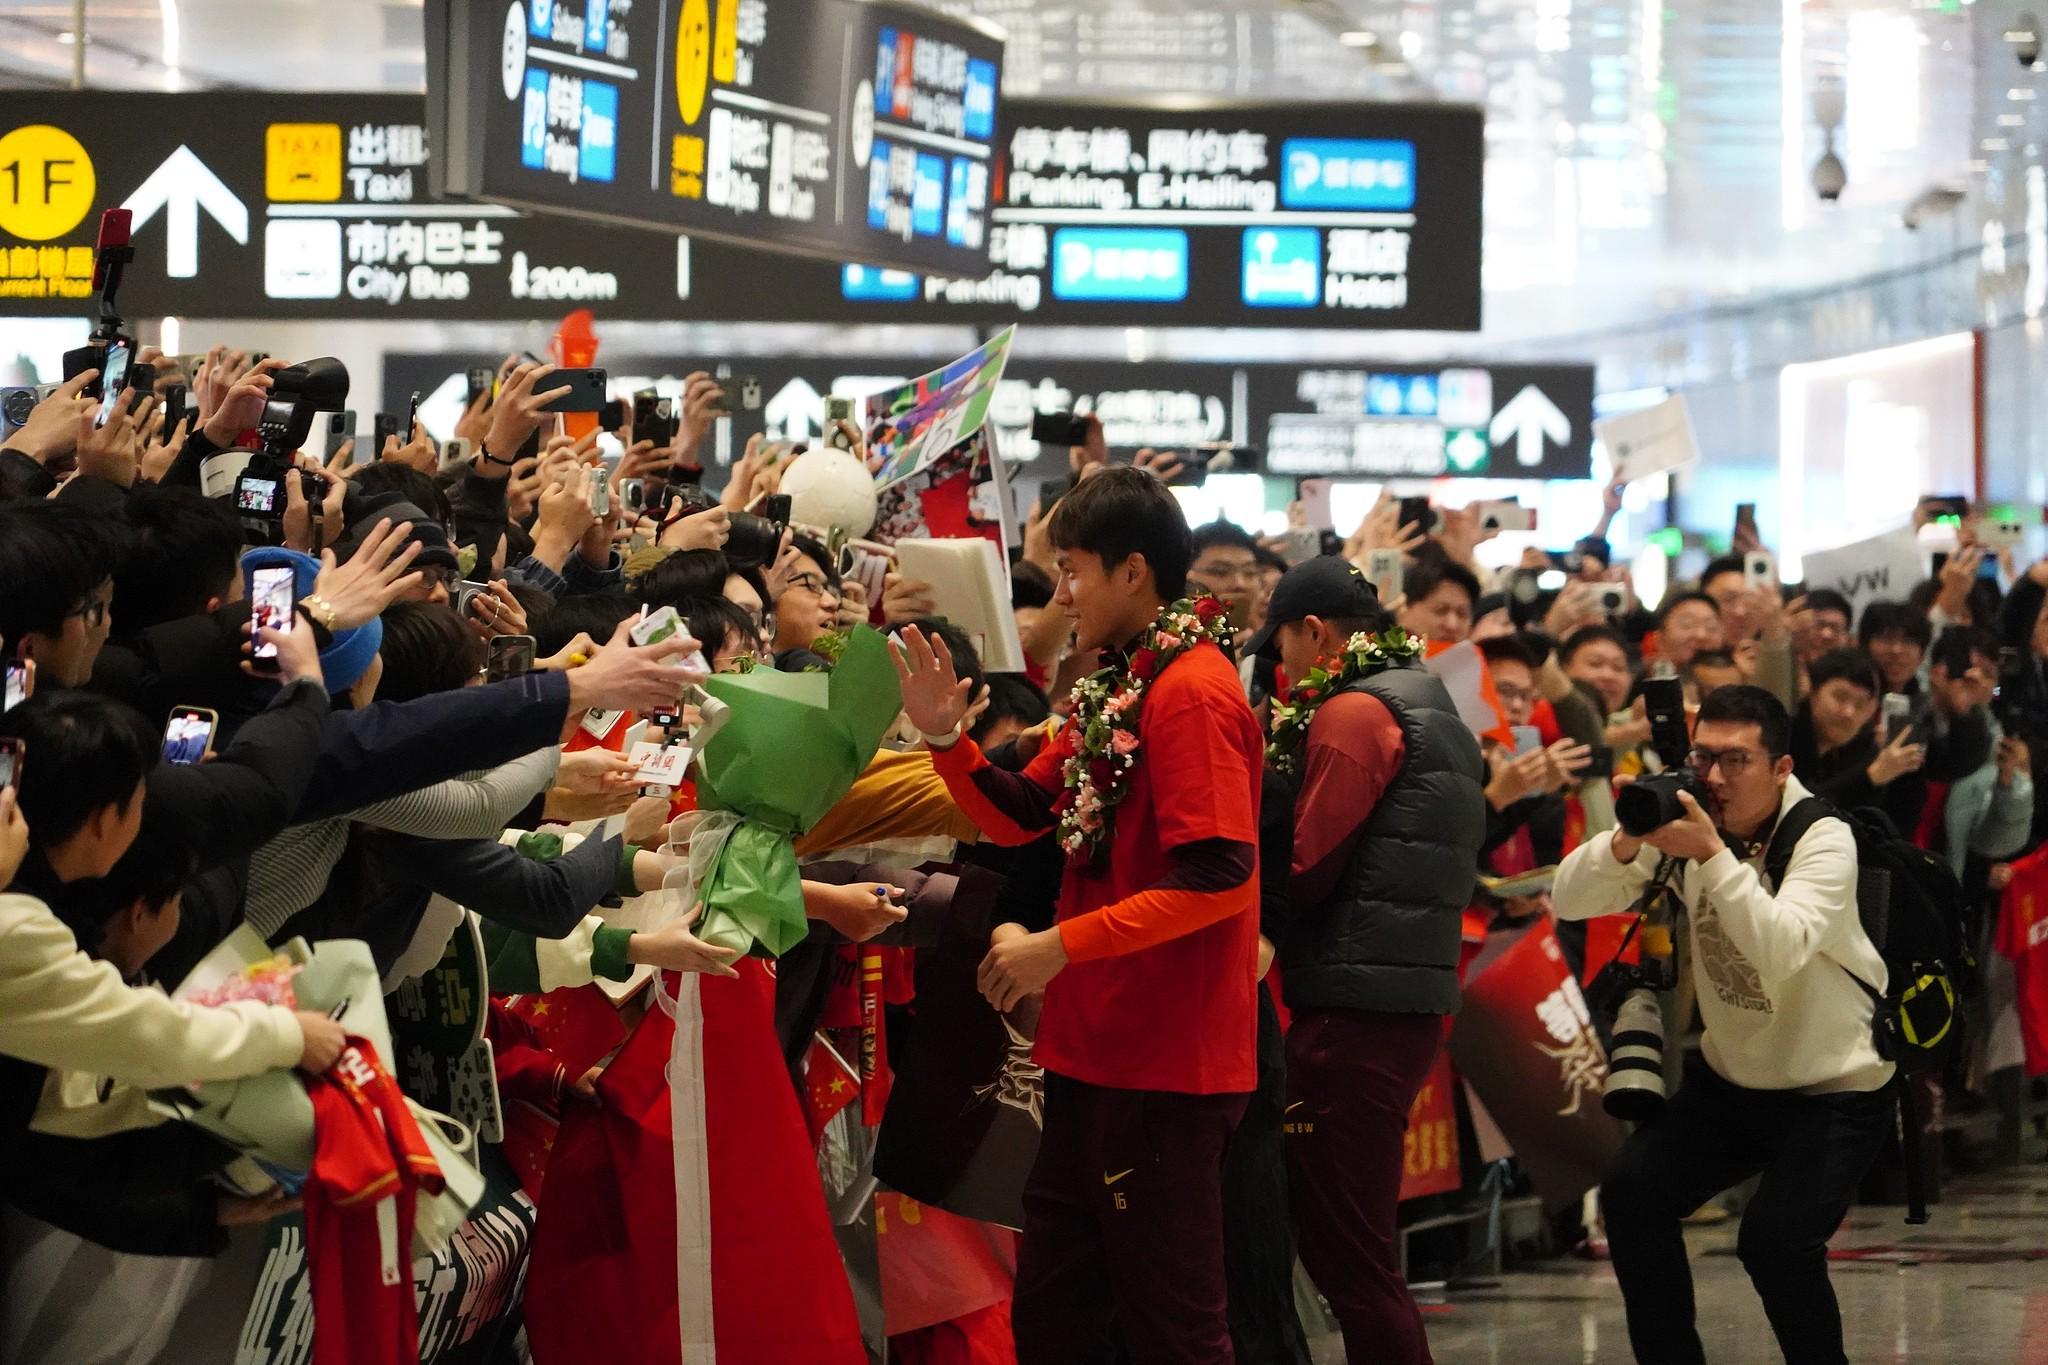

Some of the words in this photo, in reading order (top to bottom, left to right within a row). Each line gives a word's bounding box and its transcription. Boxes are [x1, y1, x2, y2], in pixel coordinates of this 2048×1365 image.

[348, 123, 430, 166] 出租
[2, 160, 76, 205] 1F
[347, 168, 413, 201] Taxi
[1137, 172, 1277, 212] E-Hailing
[346, 220, 503, 264] 市内巴士
[347, 264, 407, 305] City
[410, 265, 470, 300] Bus
[1325, 273, 1408, 309] Hotel
[1112, 1191, 1128, 1211] 16
